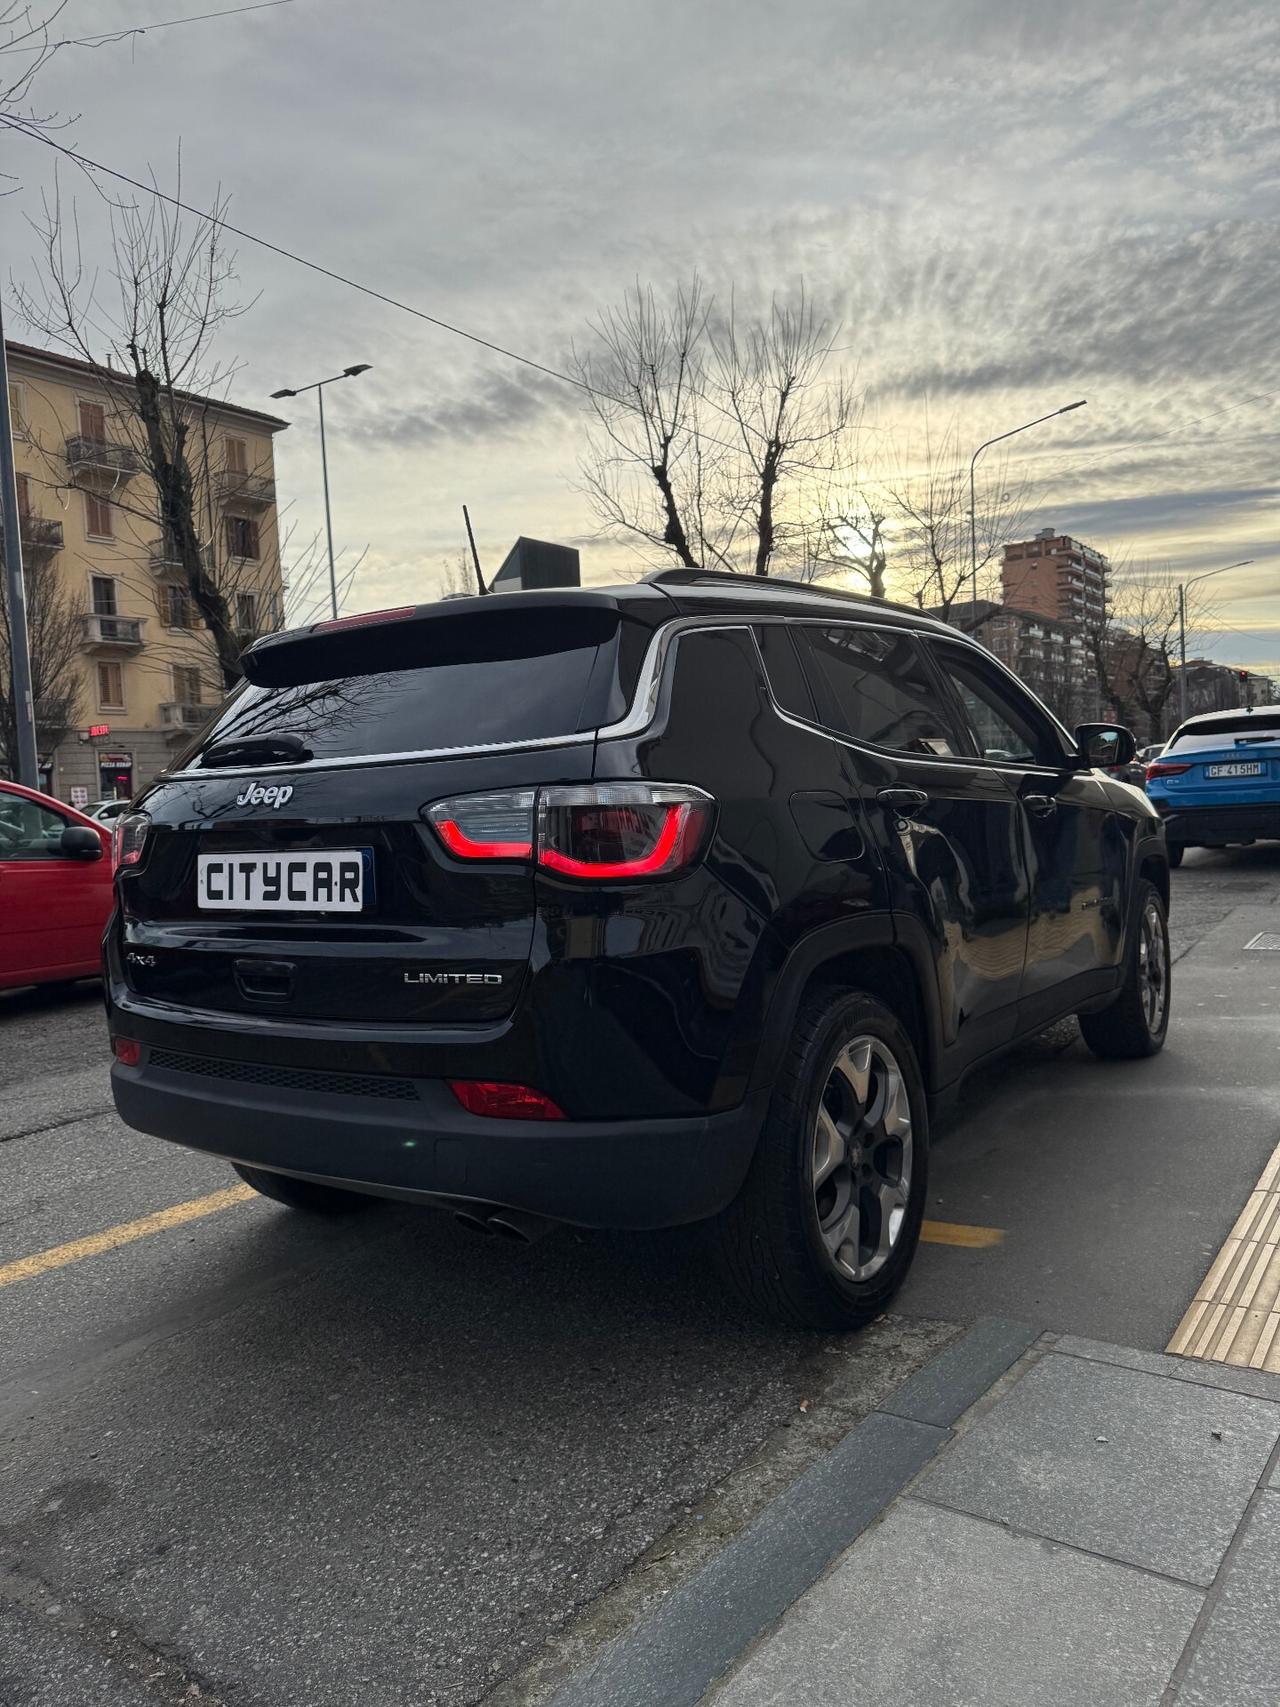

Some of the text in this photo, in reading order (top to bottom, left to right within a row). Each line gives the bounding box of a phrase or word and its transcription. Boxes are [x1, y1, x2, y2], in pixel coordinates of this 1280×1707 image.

[236, 782, 294, 809] Jeep
[206, 861, 360, 903] CITYCAR
[404, 973, 502, 984] LIMITED
